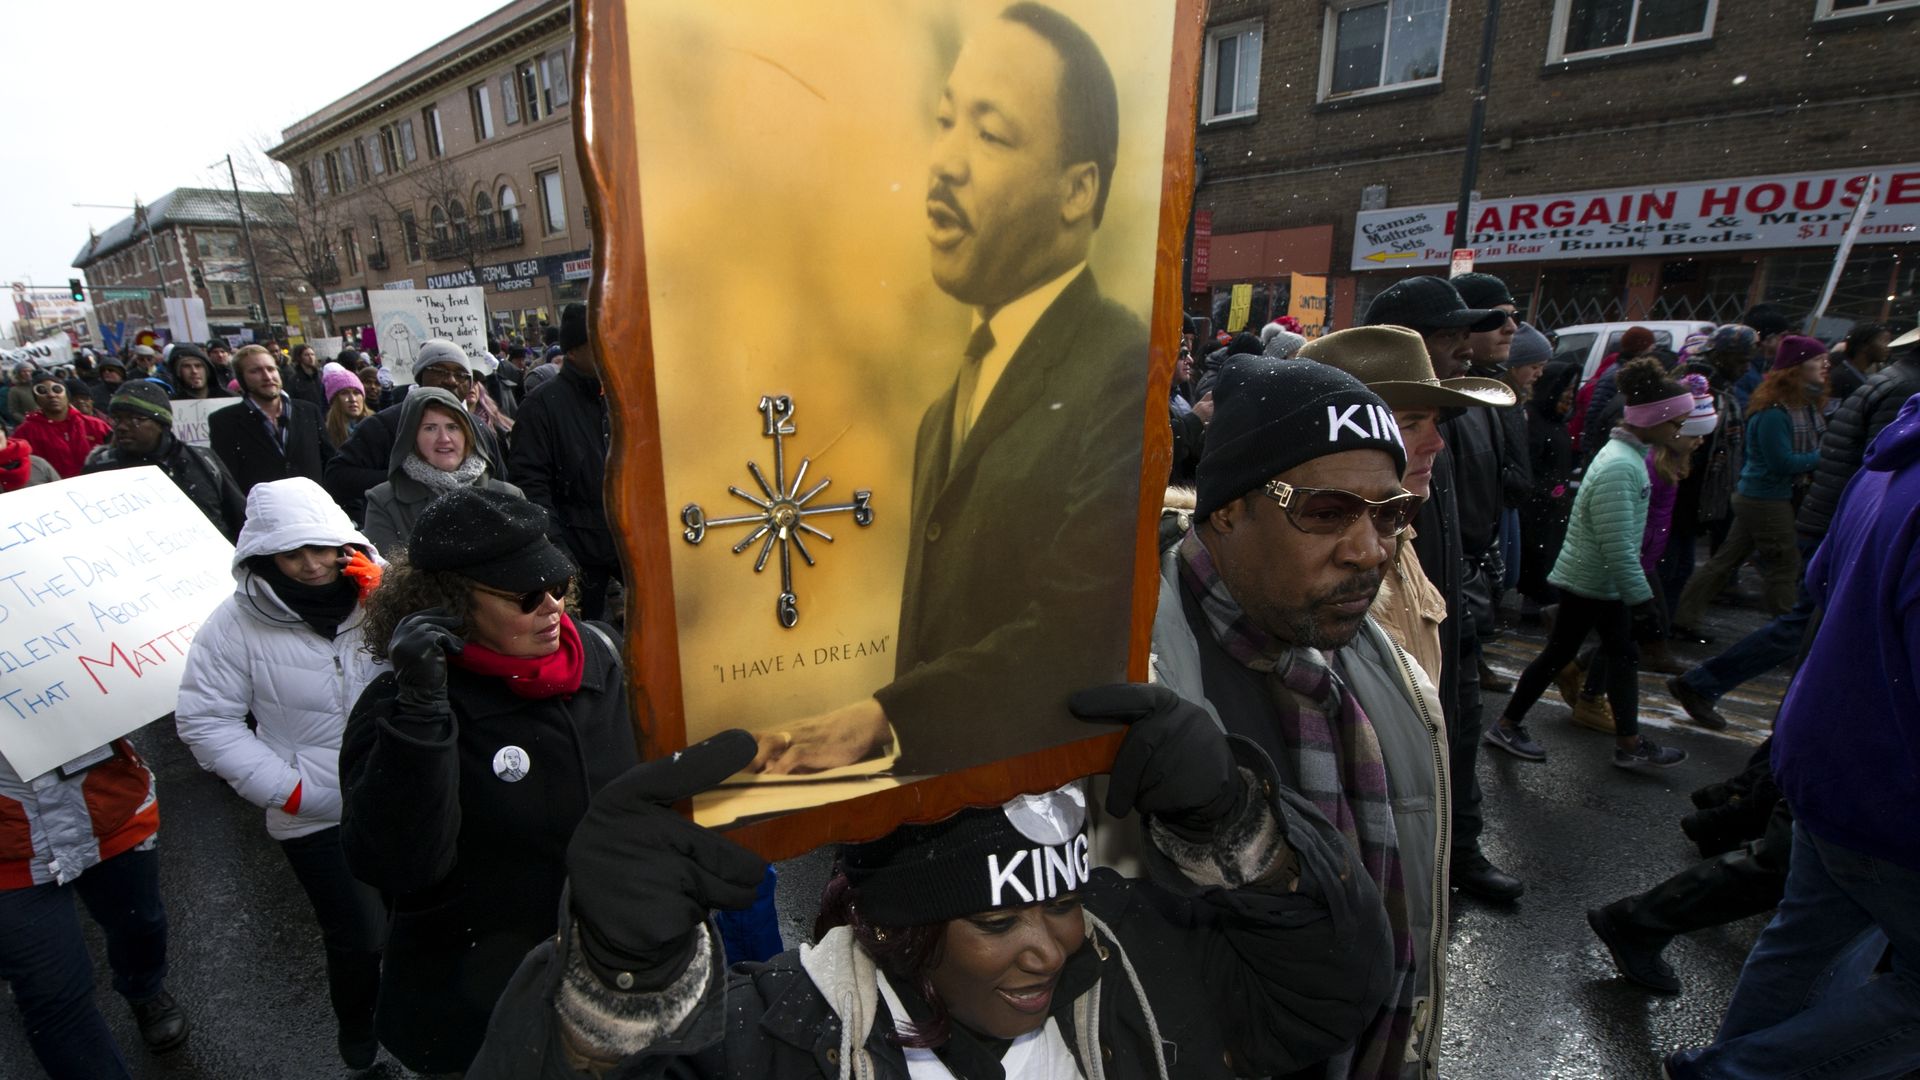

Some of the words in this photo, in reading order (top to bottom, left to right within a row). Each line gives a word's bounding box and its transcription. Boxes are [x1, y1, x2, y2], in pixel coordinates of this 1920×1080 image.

[1698, 171, 1920, 218] HOUSE
[1361, 211, 1428, 236] Camas
[1367, 222, 1435, 247] Mattress
[1470, 226, 1602, 245] Dinette
[1608, 221, 1692, 236] Sets
[1708, 216, 1743, 229] &
[1759, 211, 1877, 227] More
[1841, 222, 1917, 237] Iems
[1391, 237, 1426, 254] Sets
[1487, 244, 1500, 257] in
[1507, 241, 1545, 256] Rear
[1559, 235, 1650, 253] Bunk
[1662, 230, 1754, 246] Beds
[427, 270, 476, 289] DUMAN'S
[482, 264, 511, 283] FORMAL
[513, 260, 539, 278] WEAR
[496, 278, 533, 292] UNIFORMS
[448, 293, 470, 308] tried
[427, 312, 440, 325] to
[442, 313, 464, 327] bury
[430, 326, 454, 341] They
[457, 325, 479, 337] didn't
[758, 395, 797, 437] 12
[66, 490, 153, 526] BEGIN
[680, 503, 706, 546] 9
[854, 489, 875, 527] 3
[0, 570, 76, 608] THE
[63, 555, 119, 588] DAY
[105, 536, 157, 567] WE
[777, 592, 799, 629] 6
[0, 622, 82, 677] ILENT
[88, 591, 160, 633] ABOUT
[732, 655, 785, 682] HAVE
[792, 652, 806, 668] A
[813, 634, 890, 666] DREAM"
[0, 680, 71, 720] THAT
[987, 833, 1090, 906] KING
